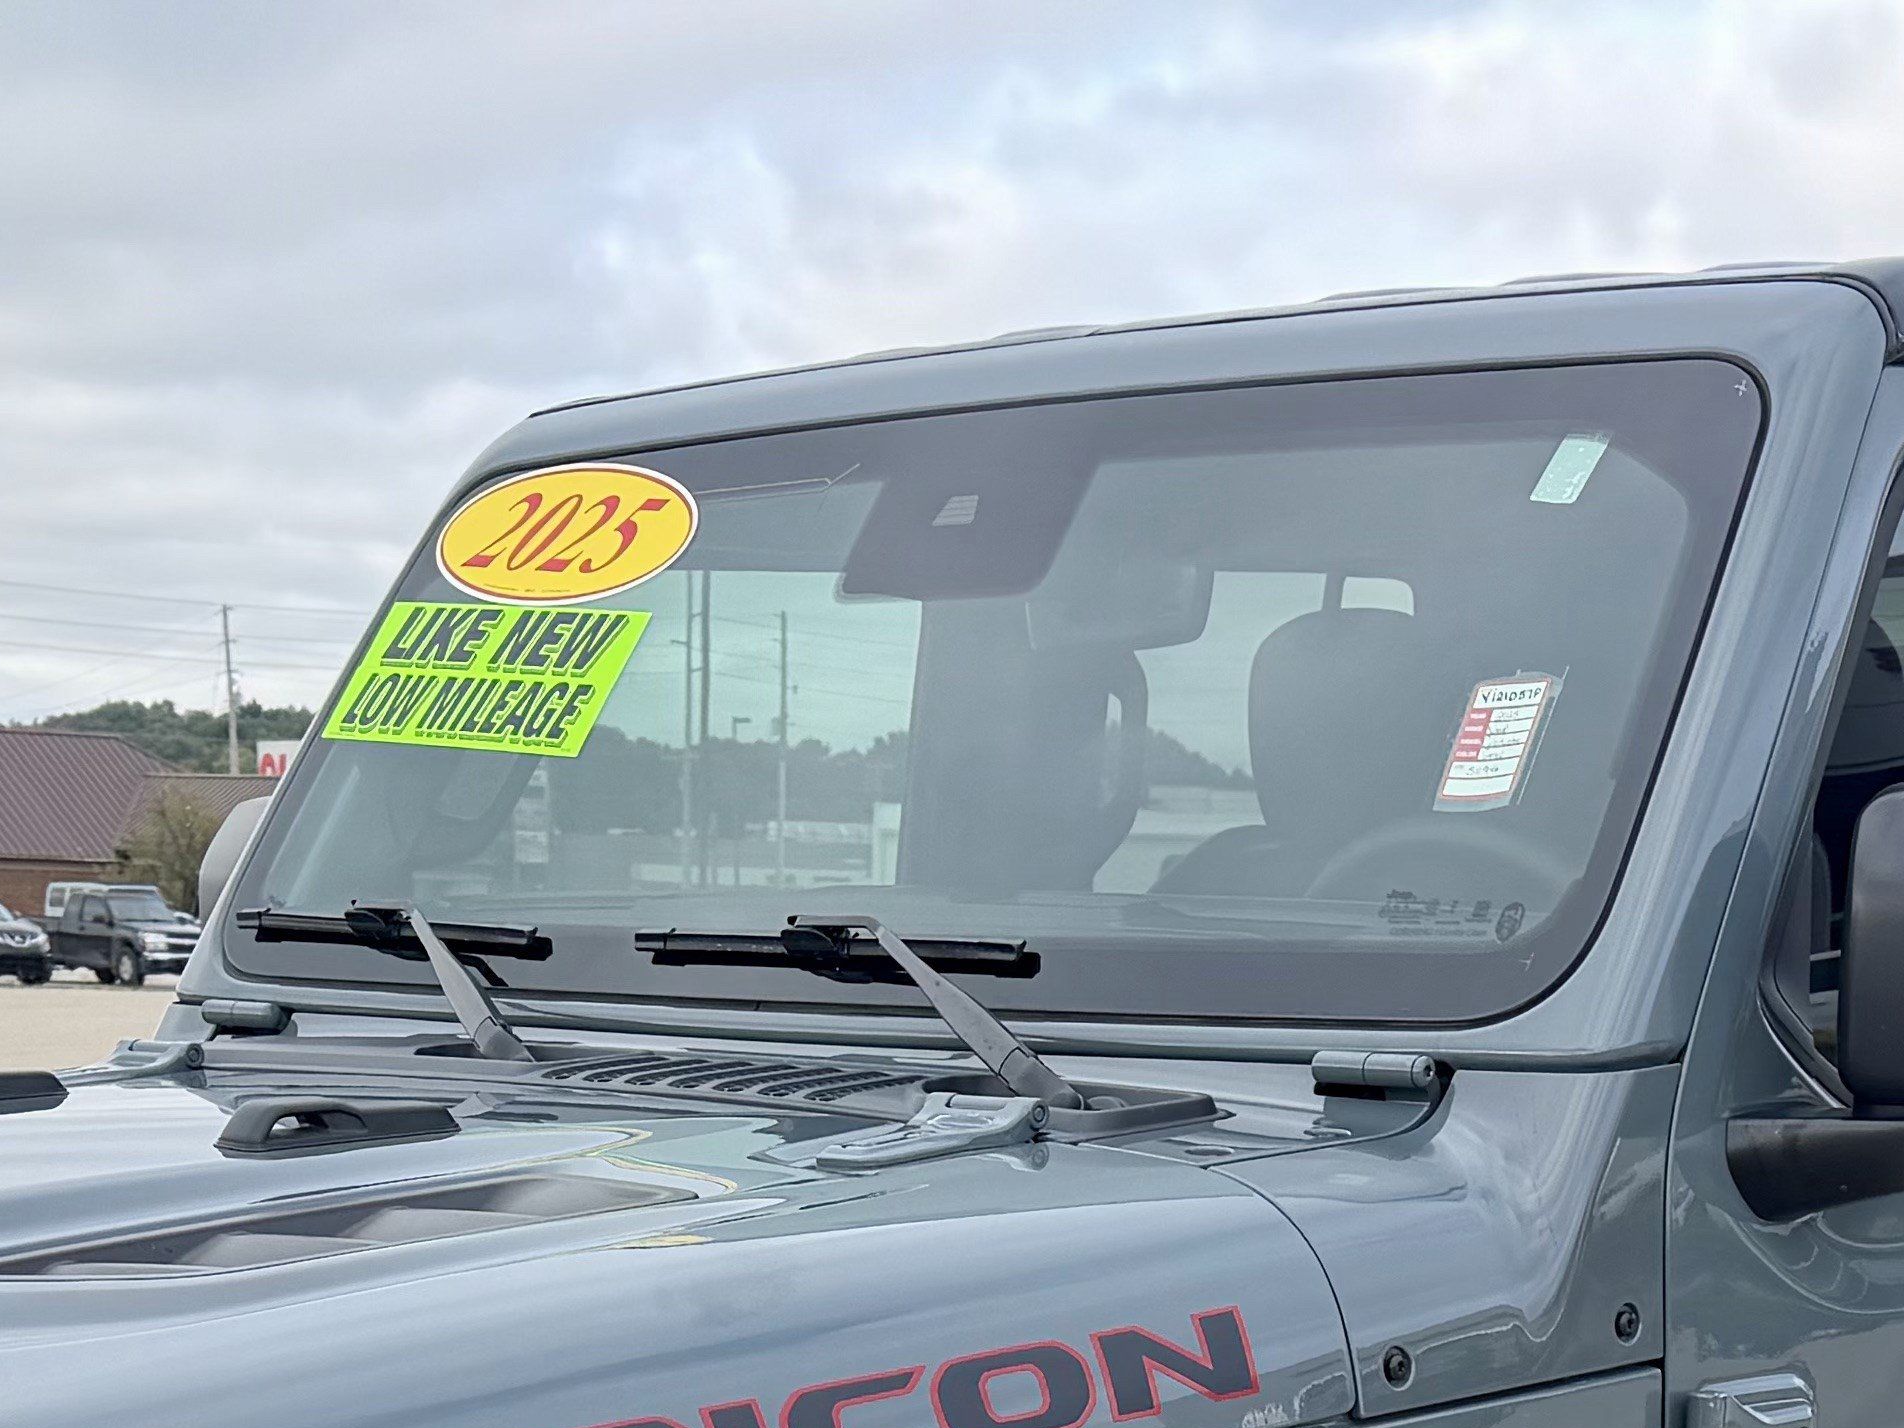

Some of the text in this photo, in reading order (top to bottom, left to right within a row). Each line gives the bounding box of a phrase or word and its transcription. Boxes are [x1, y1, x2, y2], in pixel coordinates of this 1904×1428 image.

[460, 492, 672, 574] 2025
[380, 606, 629, 678] LIKE NEW
[339, 672, 596, 748] LOW MILEAGE
